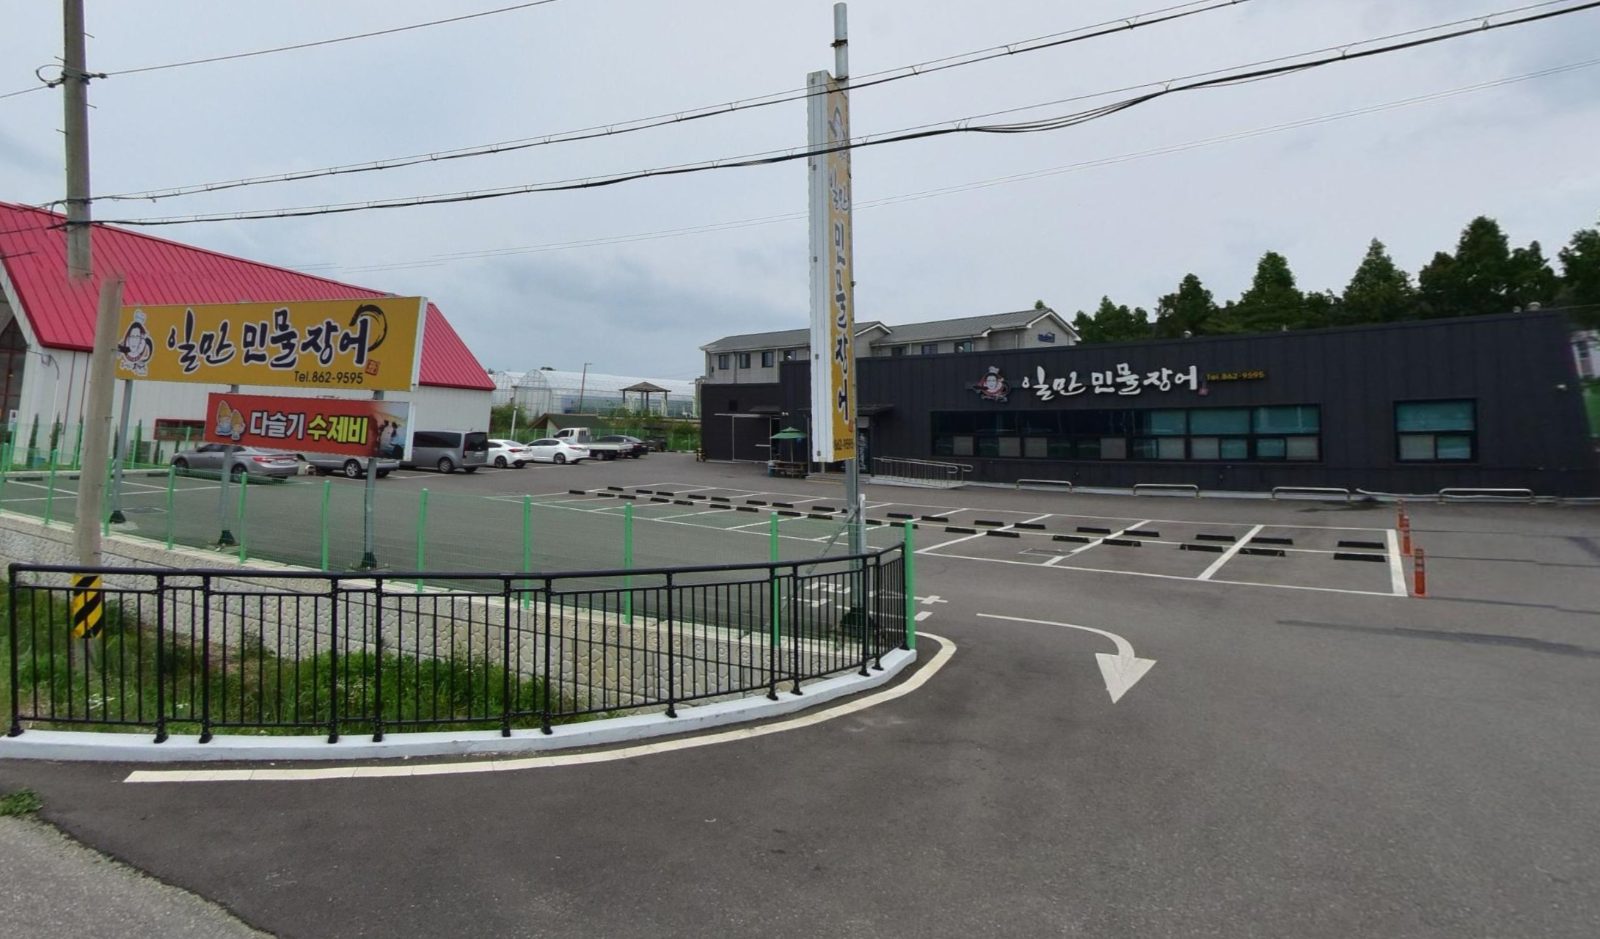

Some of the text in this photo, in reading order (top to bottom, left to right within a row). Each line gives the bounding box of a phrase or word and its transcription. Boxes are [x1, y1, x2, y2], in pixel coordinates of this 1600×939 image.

[166, 304, 388, 374] 일만 민물장어
[294, 370, 364, 385] Tel.862-9595
[1021, 362, 1198, 401] 일만 민물장어
[249, 410, 370, 445] 다슬기 수제비
